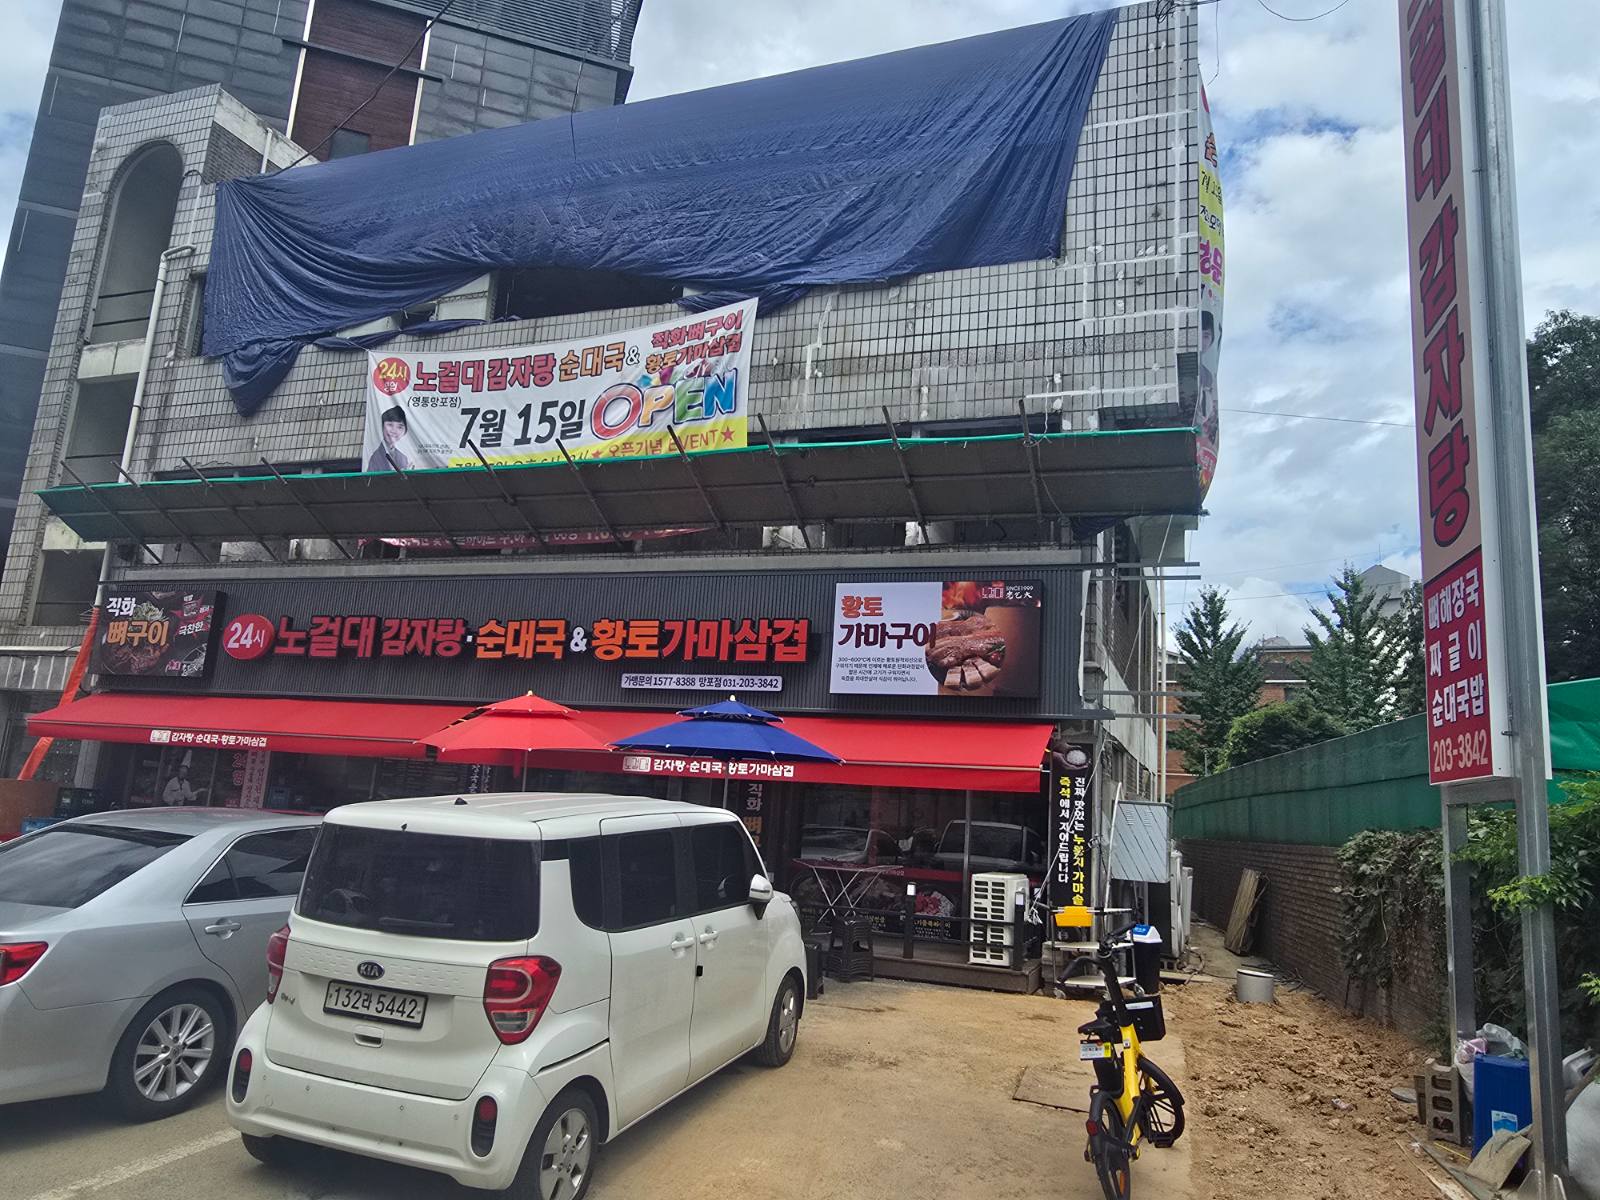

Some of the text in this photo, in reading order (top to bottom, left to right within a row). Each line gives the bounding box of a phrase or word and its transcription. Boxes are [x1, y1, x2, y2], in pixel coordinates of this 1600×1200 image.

[558, 341, 627, 382] 순대국
[626, 345, 640, 366] &
[1419, 194, 1470, 548] 감자탕
[590, 368, 738, 440] OPEN
[460, 399, 587, 448] 7월 15일
[668, 429, 719, 452] EVENT
[106, 597, 137, 617] 직화
[840, 595, 885, 619] 황토
[1427, 567, 1480, 630] 뼈해장국
[106, 620, 170, 646] 뼈구이
[227, 615, 811, 663] 24시 노걸대 감자탕 순대국 & 황토가마삼겹
[837, 622, 938, 650] 가마구이
[624, 674, 780, 689] 가맹문의 1577-8388 망포점 031-203-3842
[1431, 672, 1485, 728] 순대국밥
[1433, 729, 1489, 774] 203-3842
[1058, 776, 1071, 819] 즉석에서
[1074, 777, 1086, 798] 진짜
[360, 963, 379, 977] KIA
[333, 986, 419, 1020] 132라 5442
